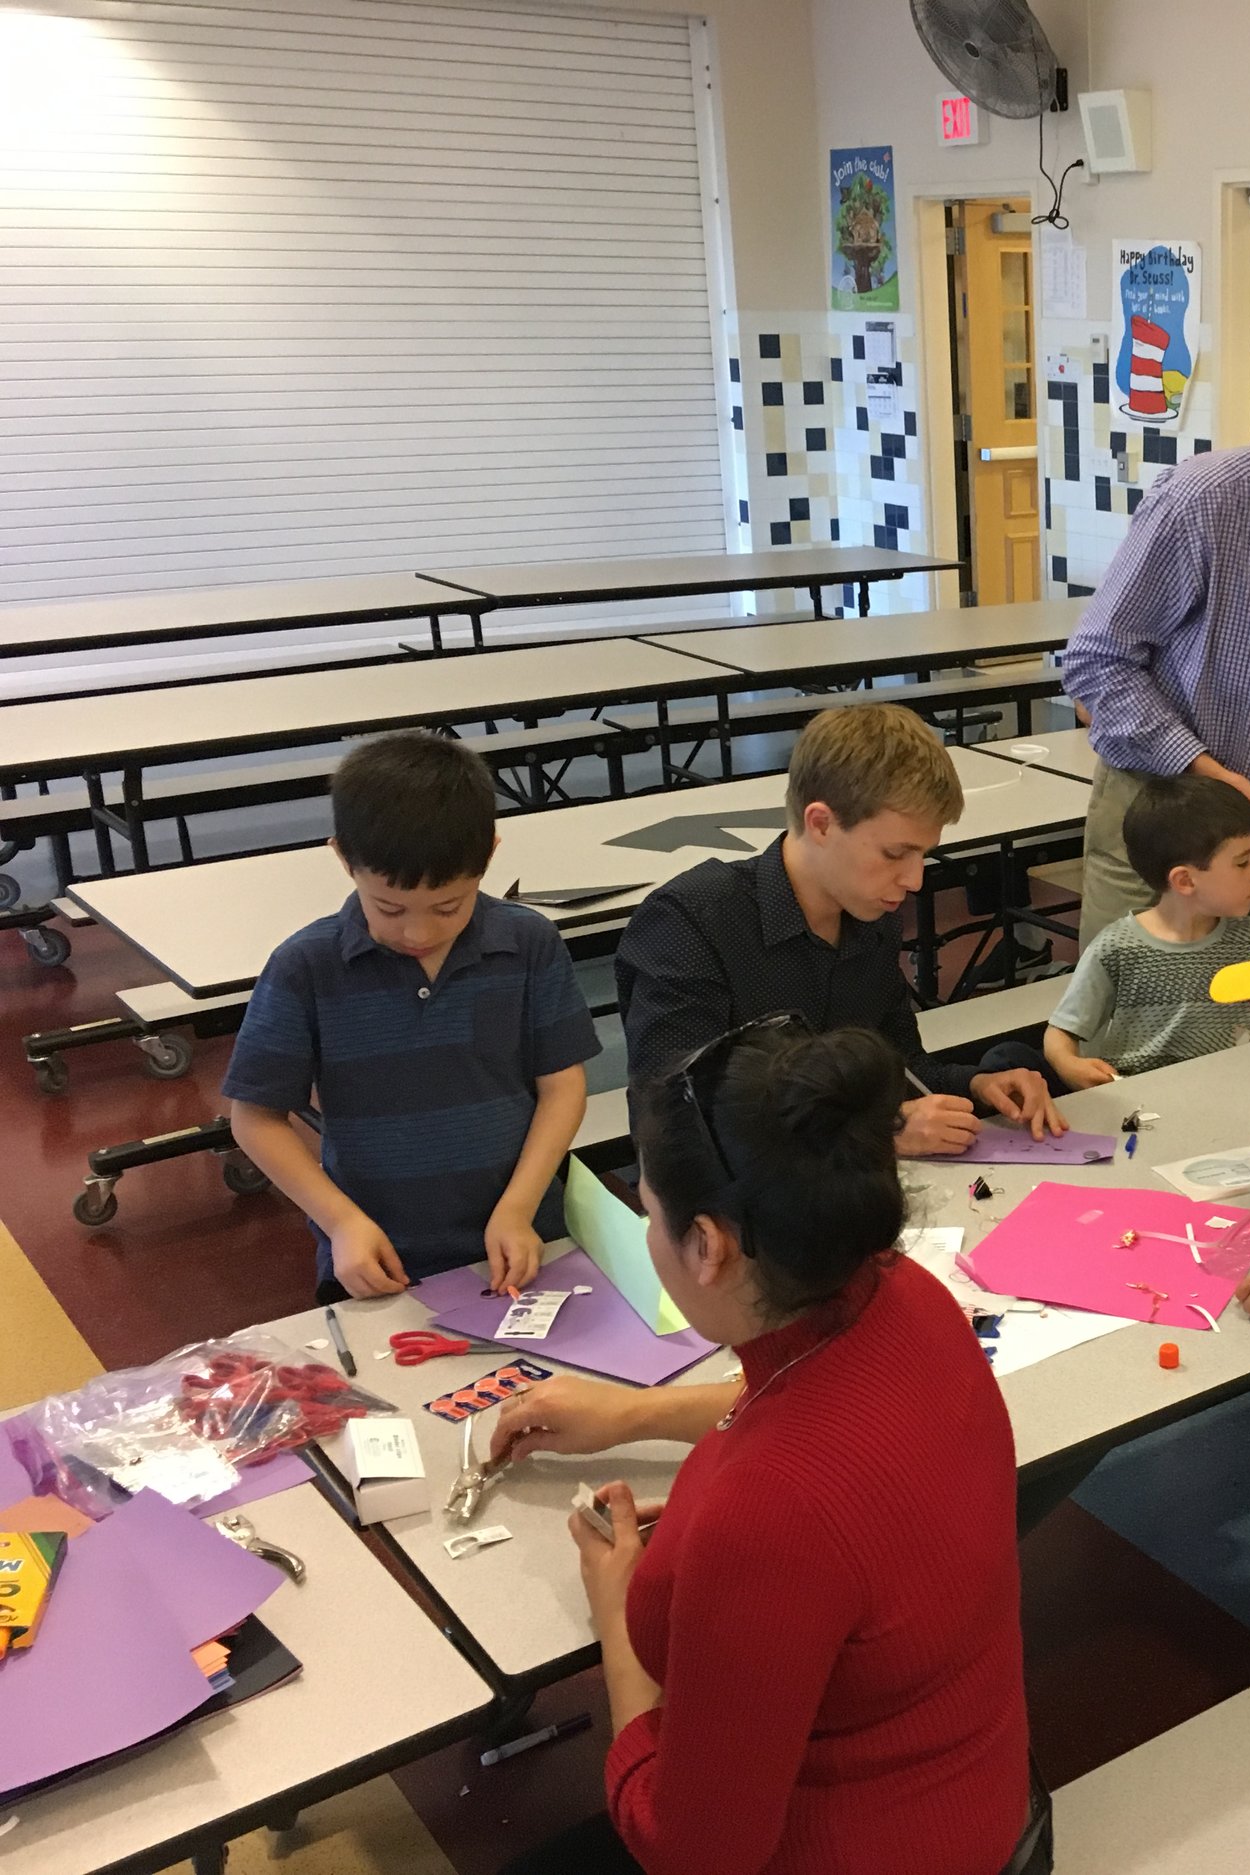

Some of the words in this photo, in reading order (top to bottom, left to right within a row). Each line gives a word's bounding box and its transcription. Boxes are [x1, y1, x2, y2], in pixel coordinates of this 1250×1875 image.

[942, 97, 970, 139] EXIT
[833, 161, 853, 187] Join
[854, 156, 867, 172] the
[869, 160, 890, 183] club!
[1120, 249, 1146, 271] Happy
[1148, 246, 1194, 273] Birthday
[1130, 270, 1140, 286] Dr.
[1142, 271, 1174, 286] Seuss!
